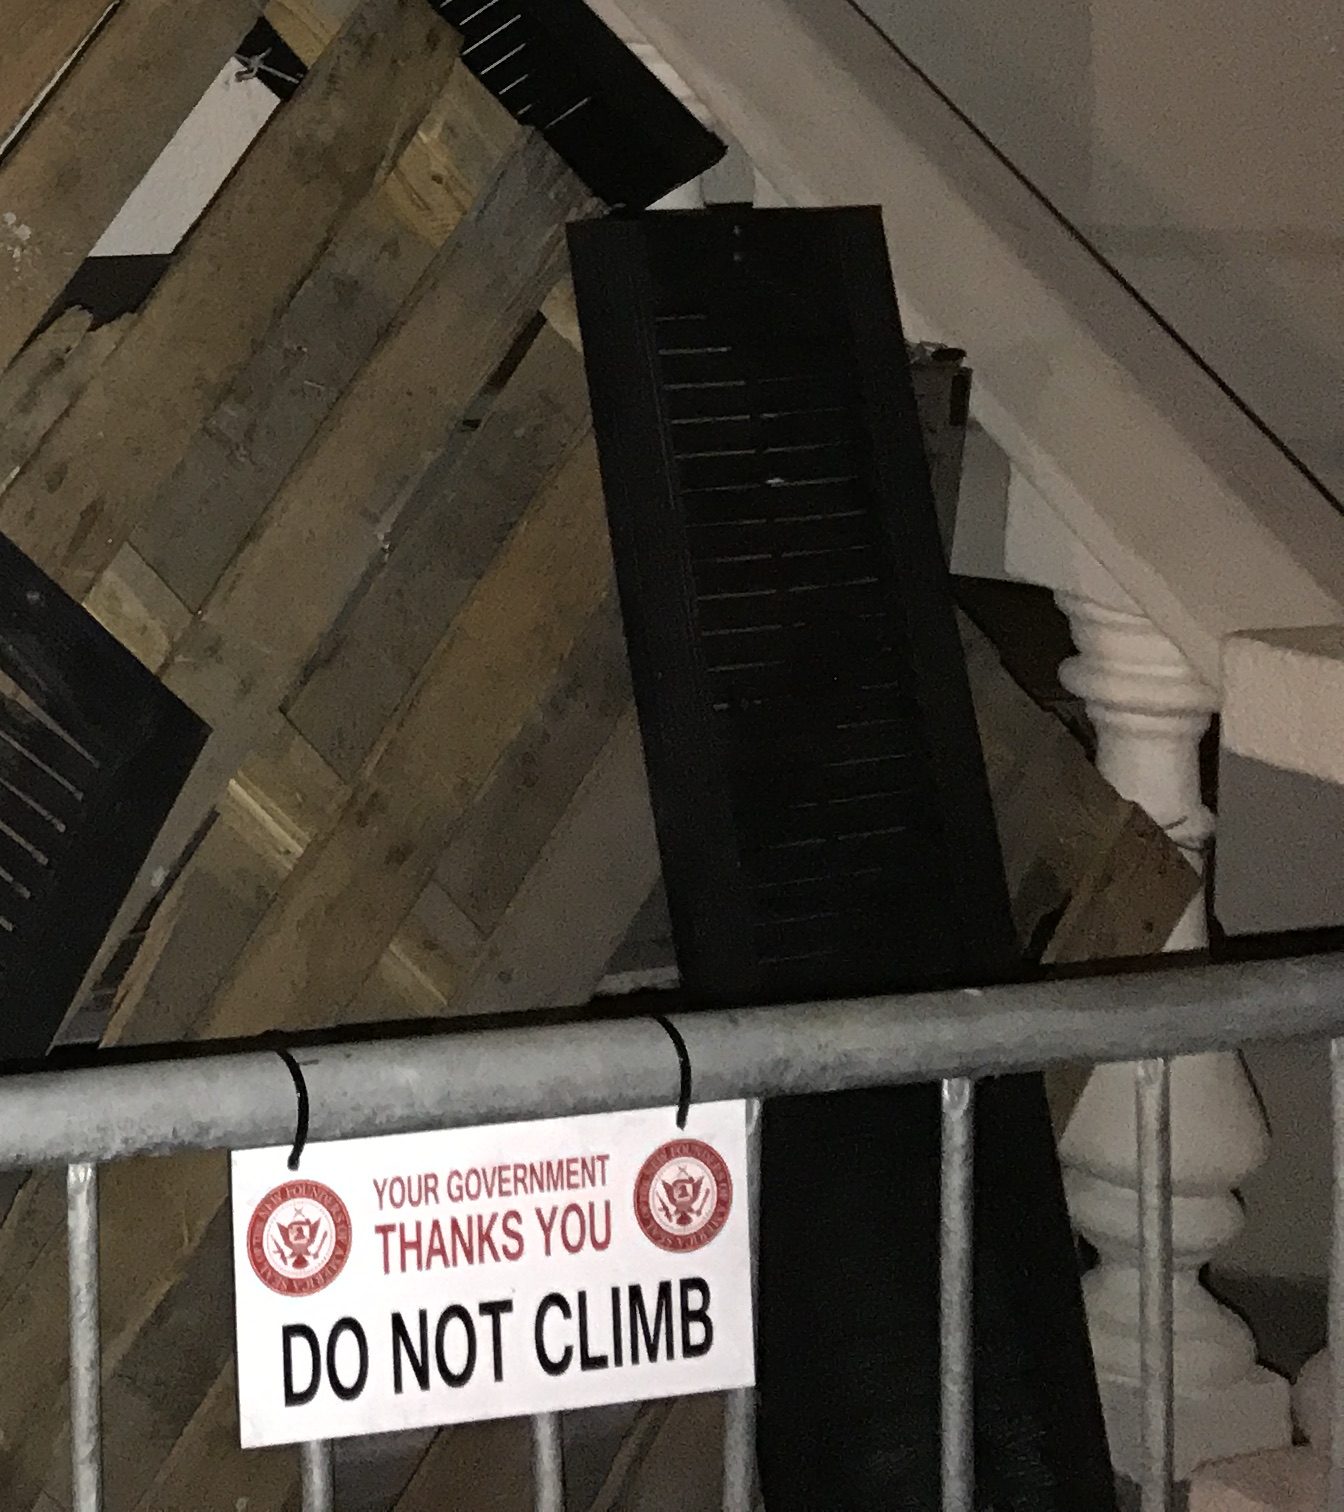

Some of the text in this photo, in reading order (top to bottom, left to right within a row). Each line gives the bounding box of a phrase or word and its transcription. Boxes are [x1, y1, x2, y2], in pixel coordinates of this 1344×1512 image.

[372, 1172, 441, 1211] YOUR
[446, 1154, 611, 1204] GOVERNMENT
[374, 1199, 612, 1276] THANKS YOU
[281, 1276, 714, 1408] DO NOT CLIMB
